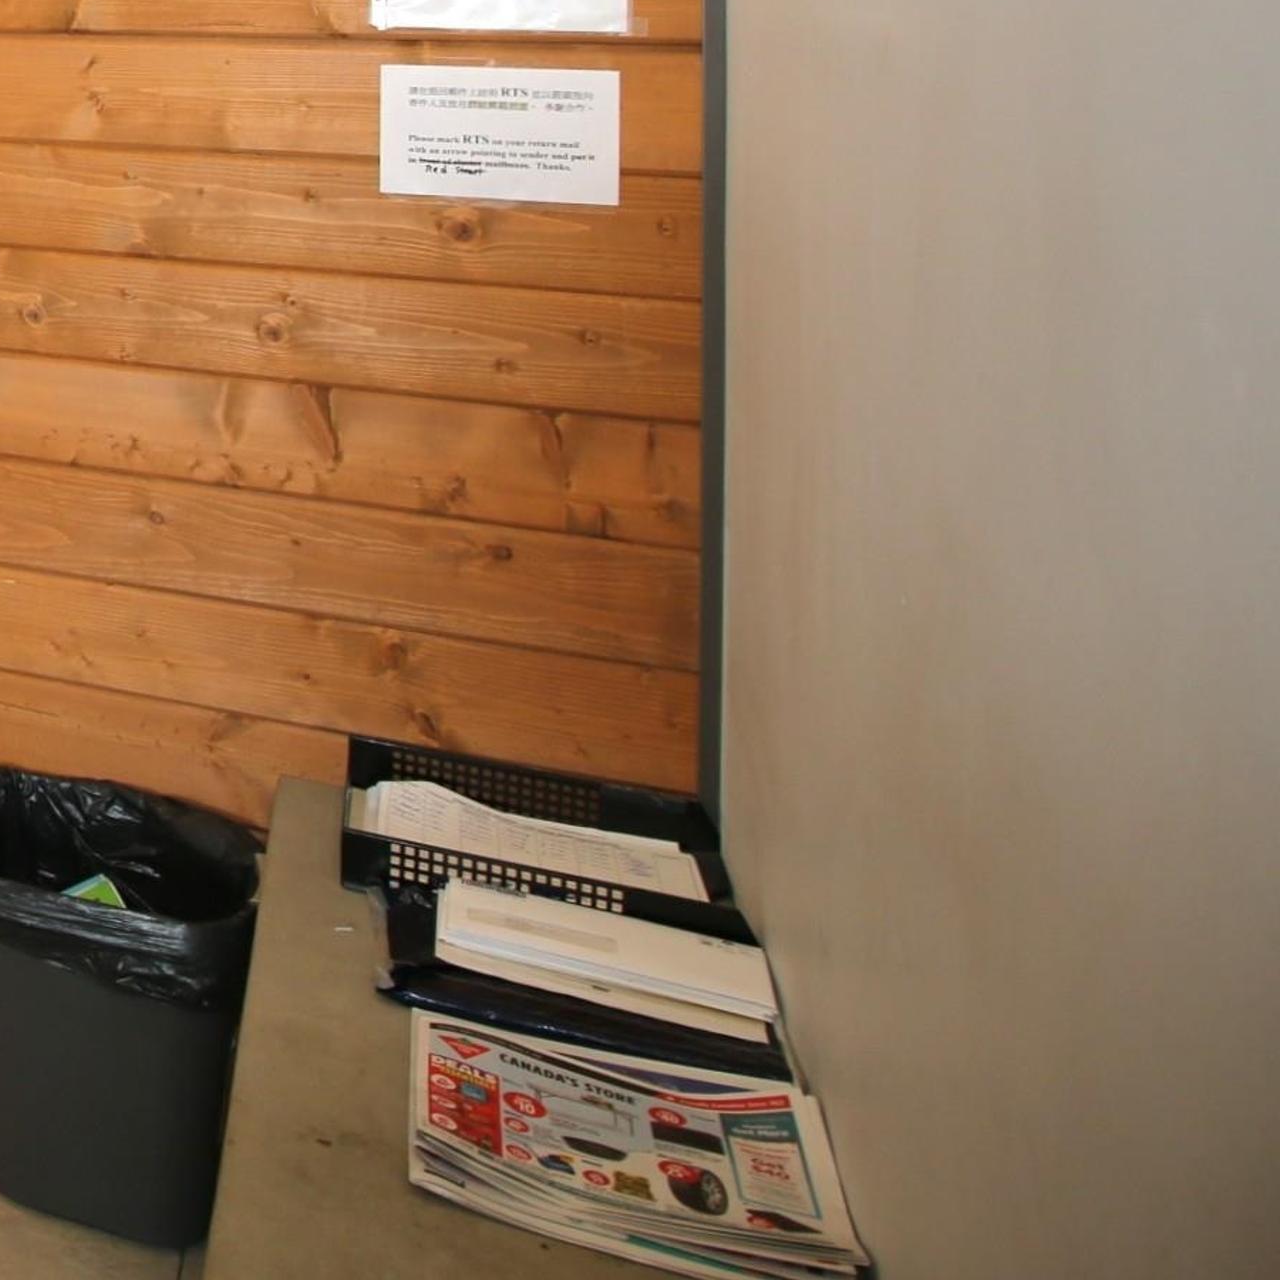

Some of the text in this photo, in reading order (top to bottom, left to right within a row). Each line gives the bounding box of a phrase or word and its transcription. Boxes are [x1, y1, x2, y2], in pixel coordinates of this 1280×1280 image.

[462, 134, 490, 145] RTS
[499, 1052, 580, 1088] CANADA'S
[584, 1082, 637, 1106] STORE
